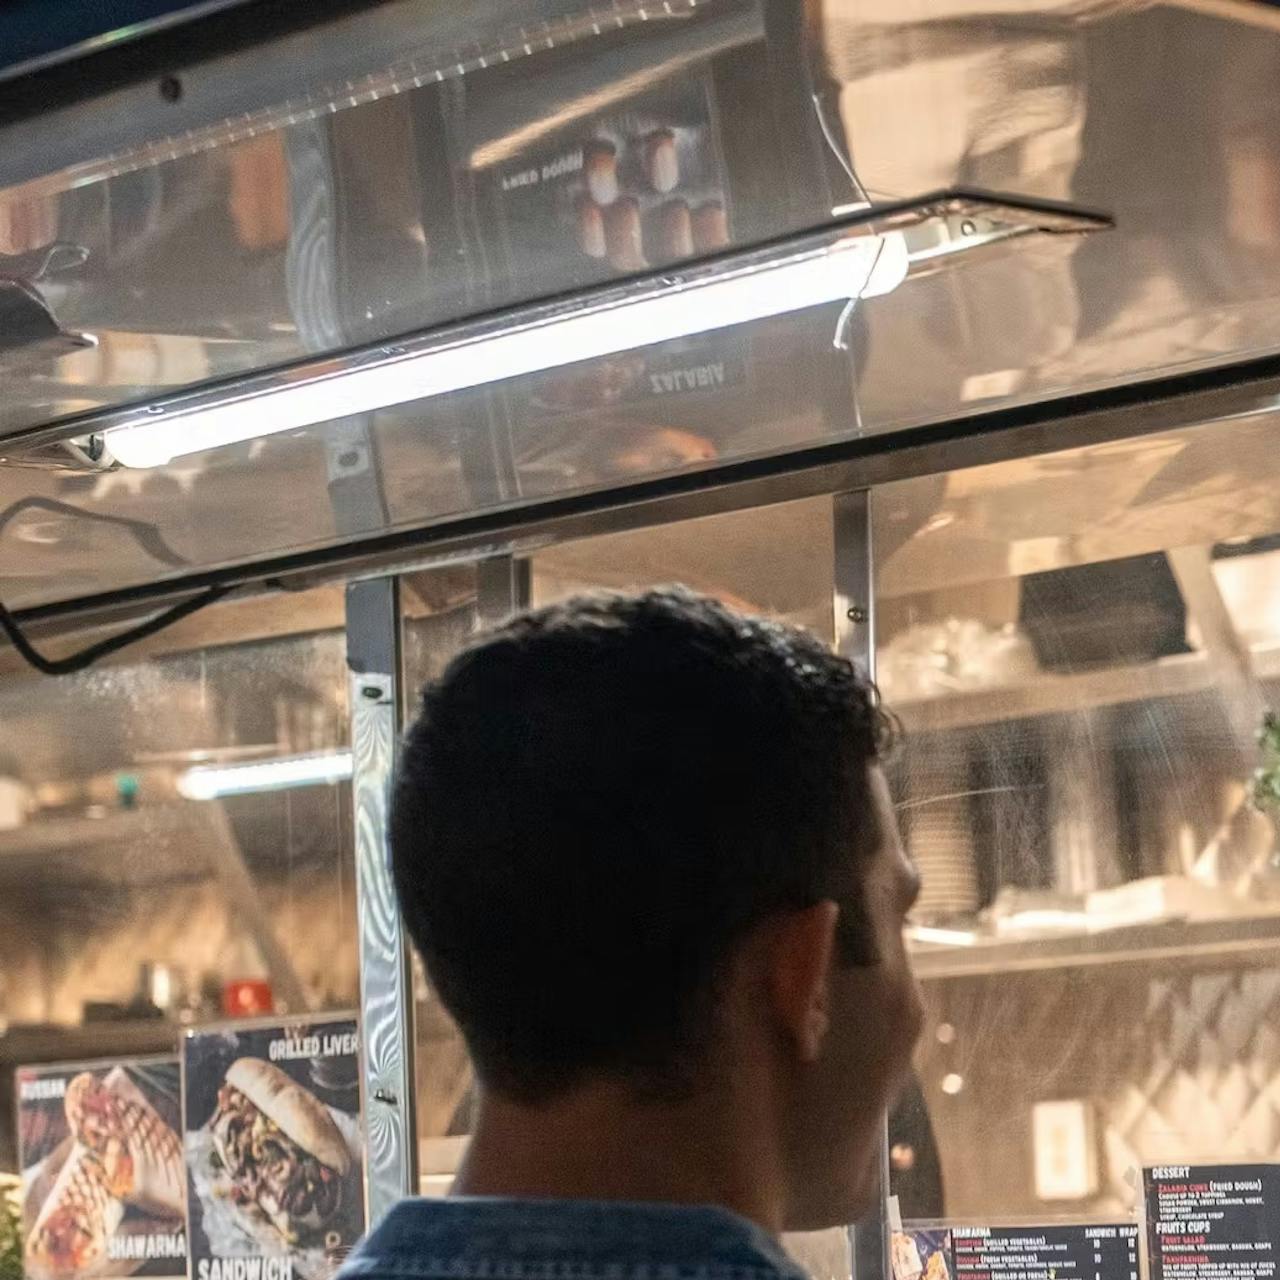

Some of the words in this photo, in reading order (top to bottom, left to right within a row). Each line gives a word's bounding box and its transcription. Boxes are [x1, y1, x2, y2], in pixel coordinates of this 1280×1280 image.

[269, 1037, 320, 1060] GRILLED
[324, 1033, 359, 1055] LIVER
[1153, 1166, 1190, 1179] DESSERT
[952, 1228, 991, 1238] SHAWARMA
[1085, 1228, 1116, 1238] SANDWICH
[1120, 1227, 1138, 1238] WRAP
[1156, 1222, 1186, 1234] FRUITS
[1188, 1221, 1211, 1233] CUPS
[108, 1234, 187, 1260] SHAWARMA
